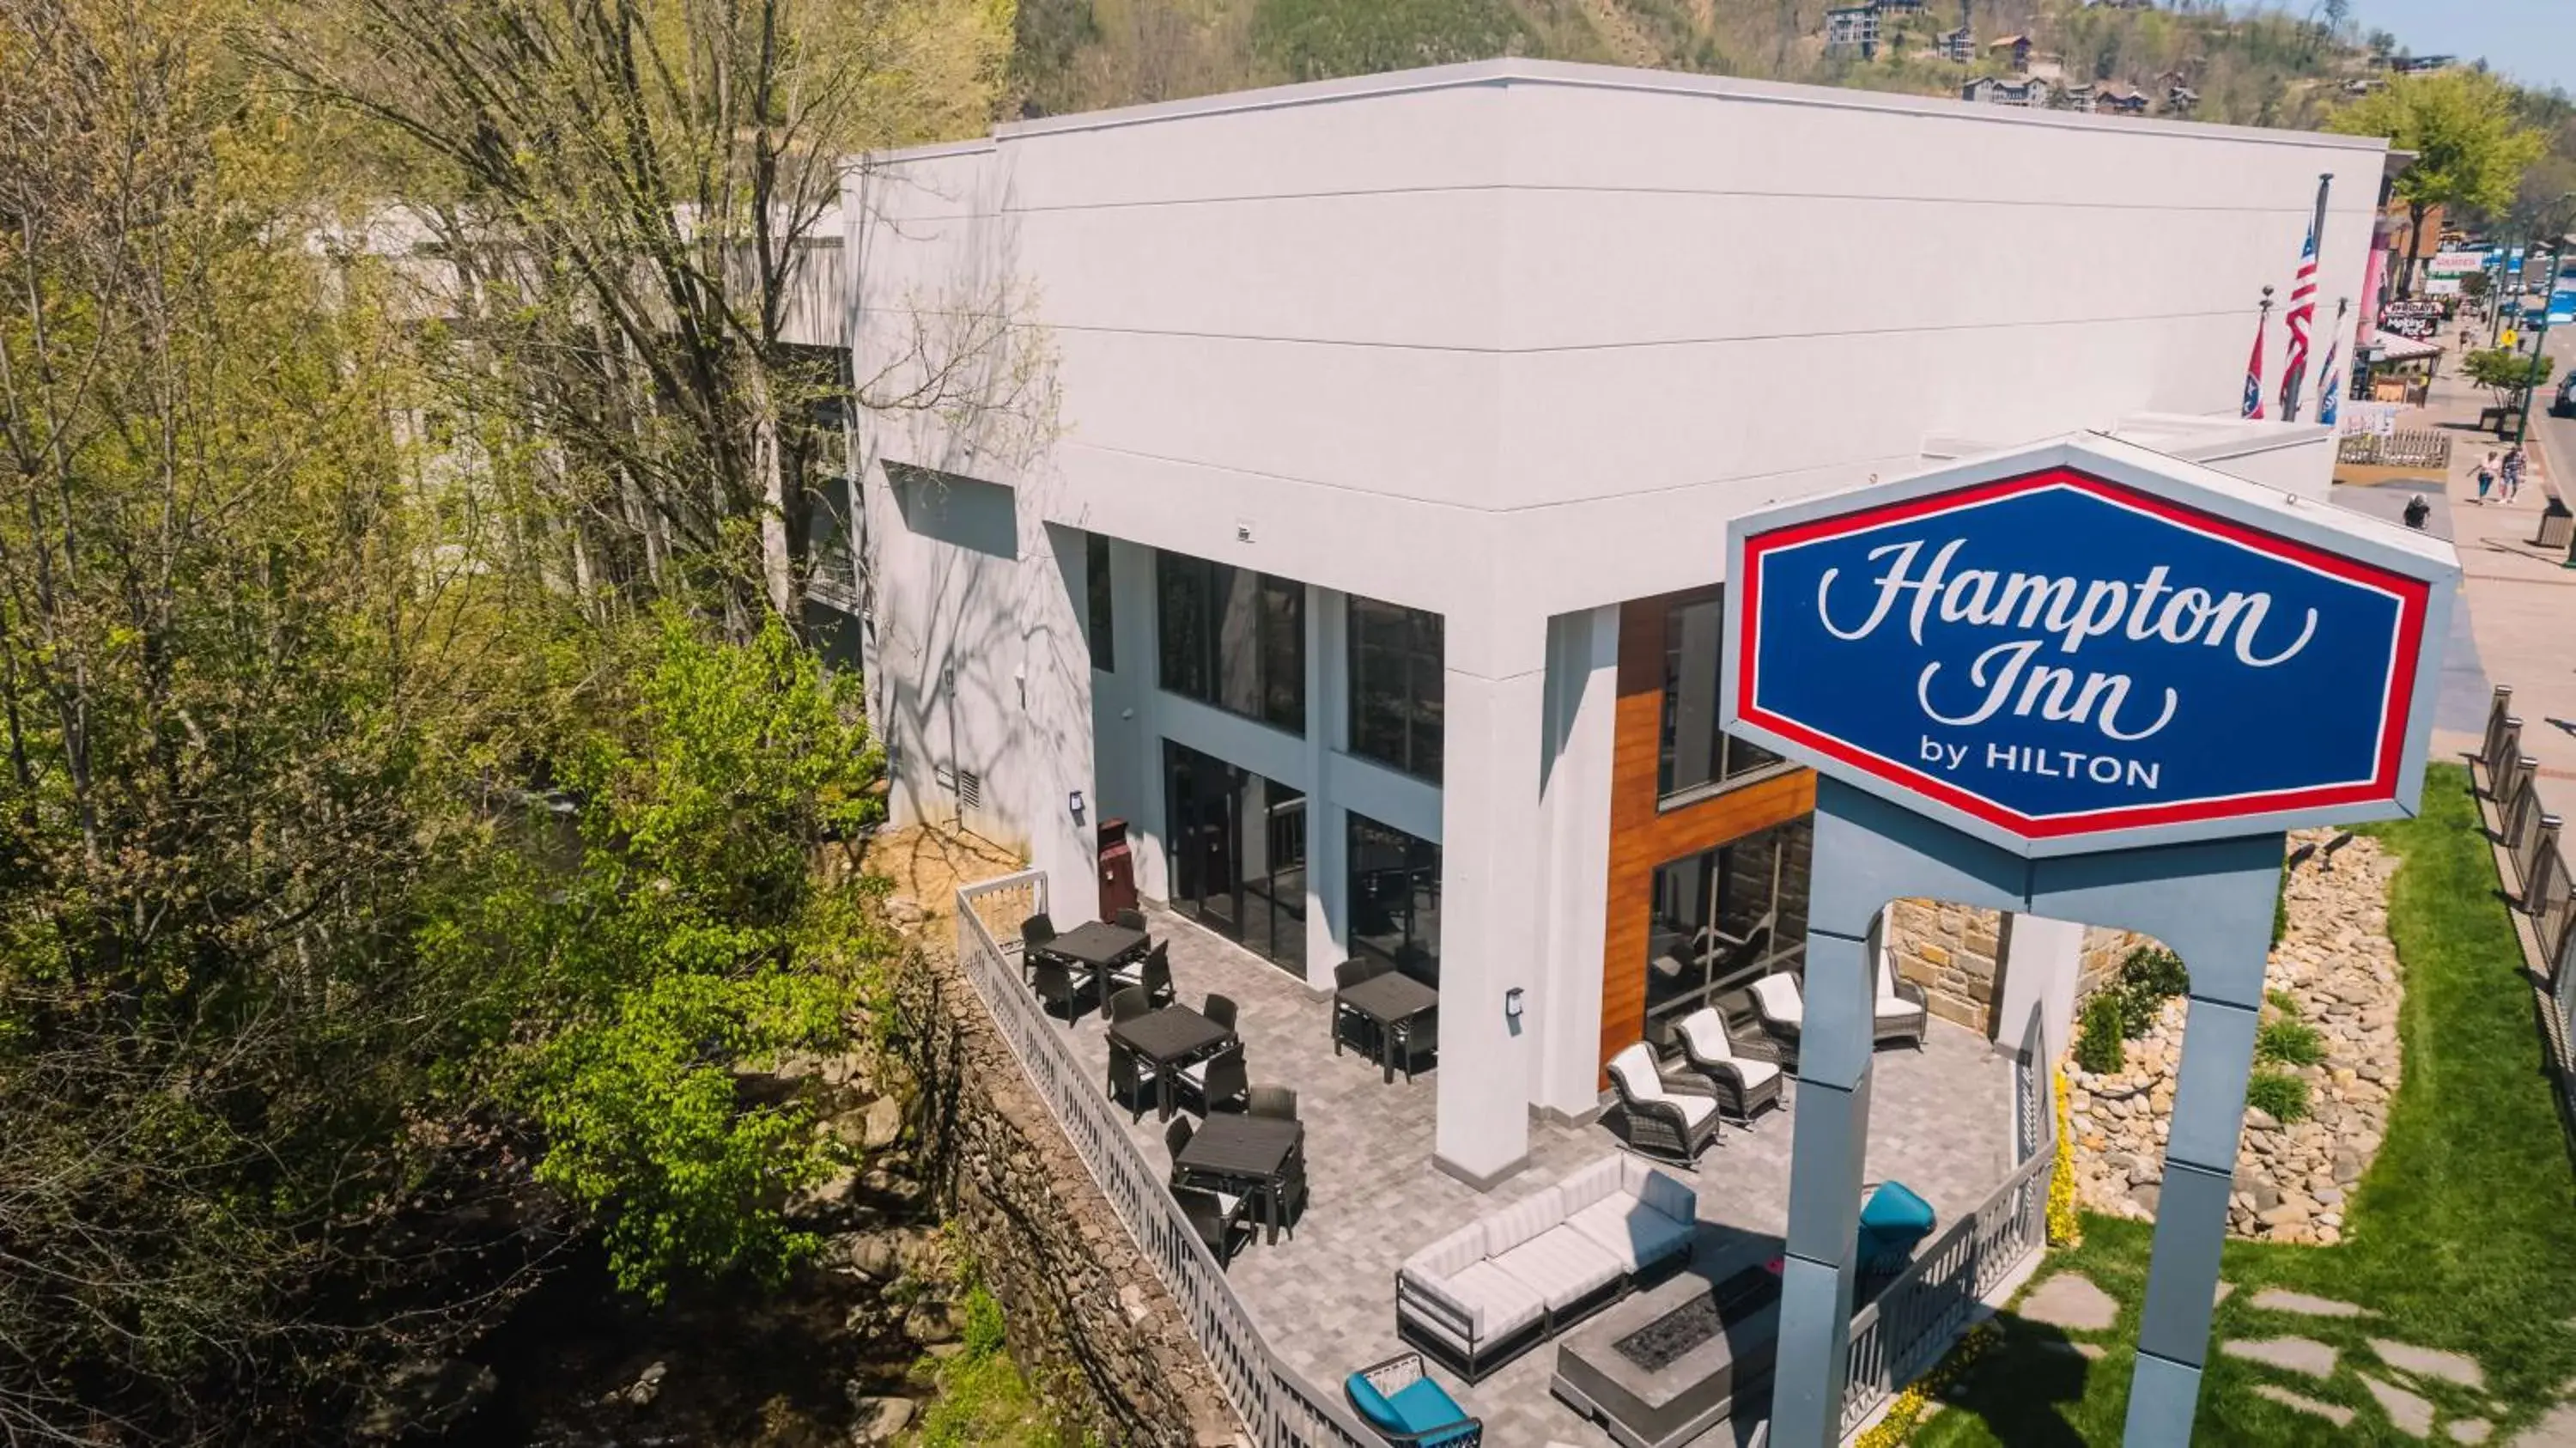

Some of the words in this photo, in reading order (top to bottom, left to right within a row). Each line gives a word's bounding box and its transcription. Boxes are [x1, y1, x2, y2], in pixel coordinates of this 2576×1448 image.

[1818, 538, 2318, 667] Hampton
[1917, 640, 2178, 741] Inn
[1921, 734, 1968, 770] by
[1986, 743, 2160, 790] HILTON
